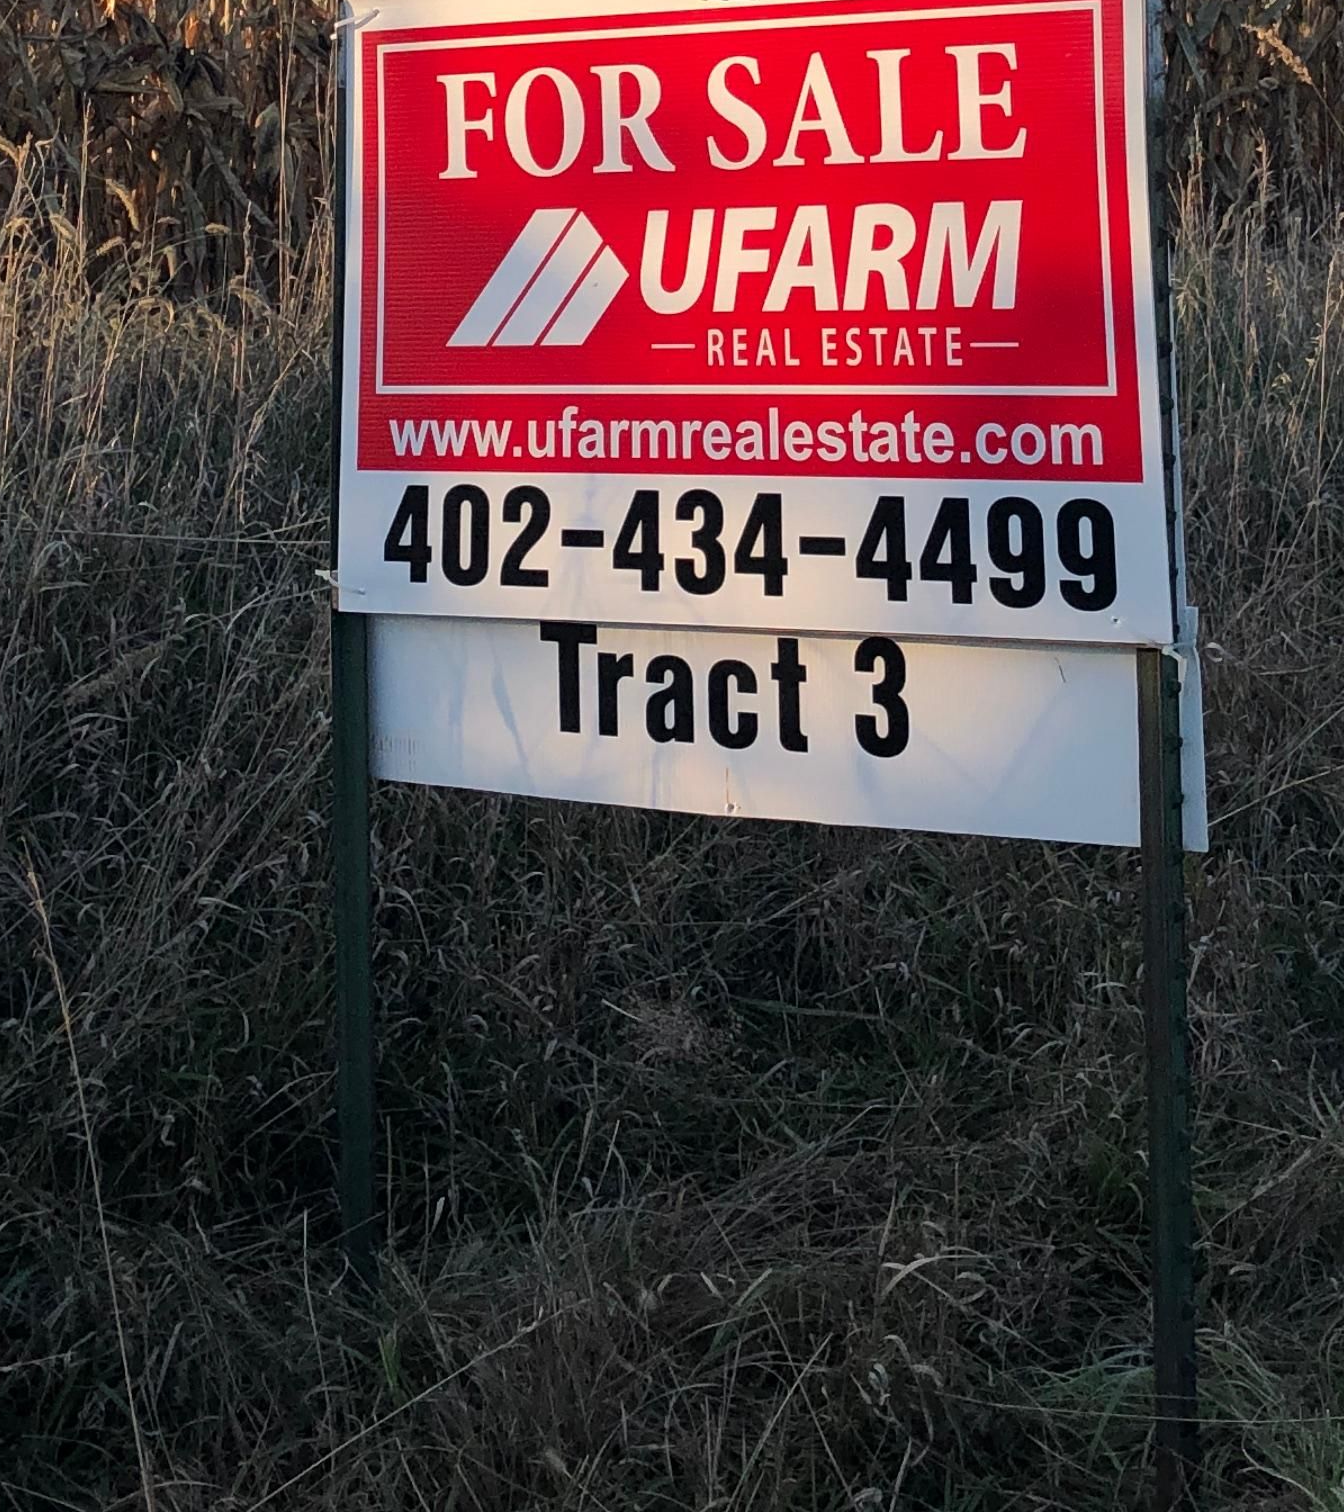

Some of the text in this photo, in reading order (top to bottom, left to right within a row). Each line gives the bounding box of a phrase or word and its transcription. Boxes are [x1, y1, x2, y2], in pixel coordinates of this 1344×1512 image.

[436, 42, 1028, 180] FOR SALE
[639, 199, 1024, 316] UFARM
[706, 326, 965, 368] REAL ESTATE
[389, 405, 1104, 467] www.ufarmrealestate.com
[383, 483, 1118, 612] 402-434-4499
[539, 620, 910, 759] Tract 3
